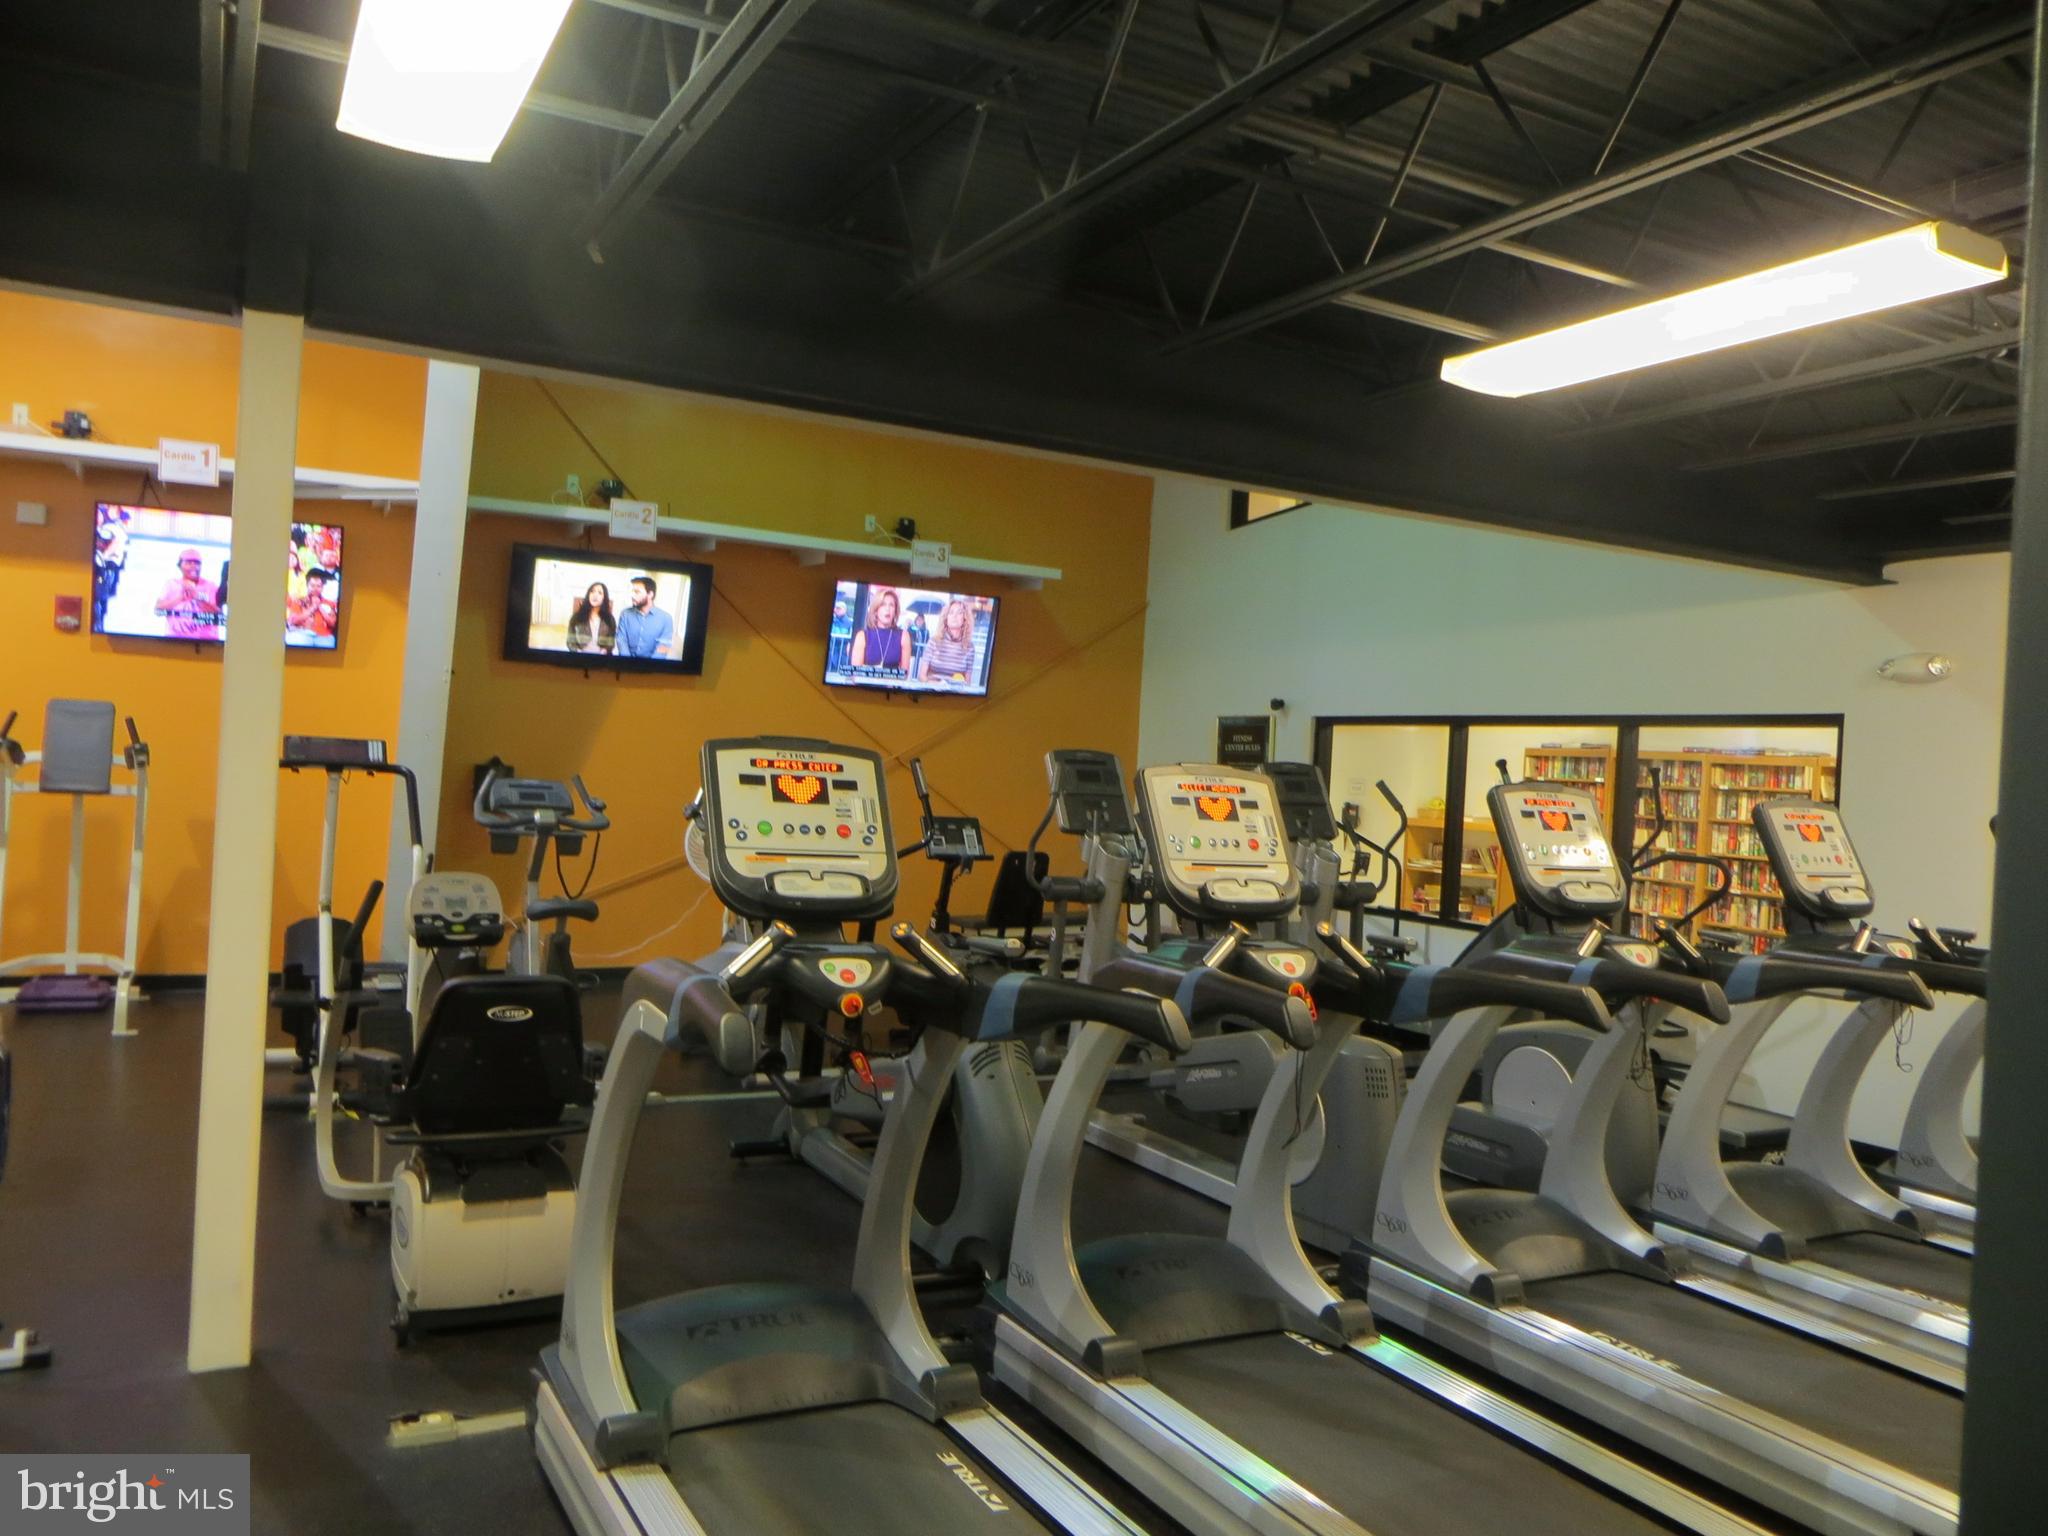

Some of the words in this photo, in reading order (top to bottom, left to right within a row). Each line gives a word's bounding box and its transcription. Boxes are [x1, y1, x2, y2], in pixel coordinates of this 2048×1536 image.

[201, 449, 210, 467] 1
[641, 507, 653, 525] 2
[937, 547, 946, 562] 3
[773, 758, 804, 771] PRESS
[808, 761, 838, 773] ENTER
[936, 1451, 992, 1498] TRUE
